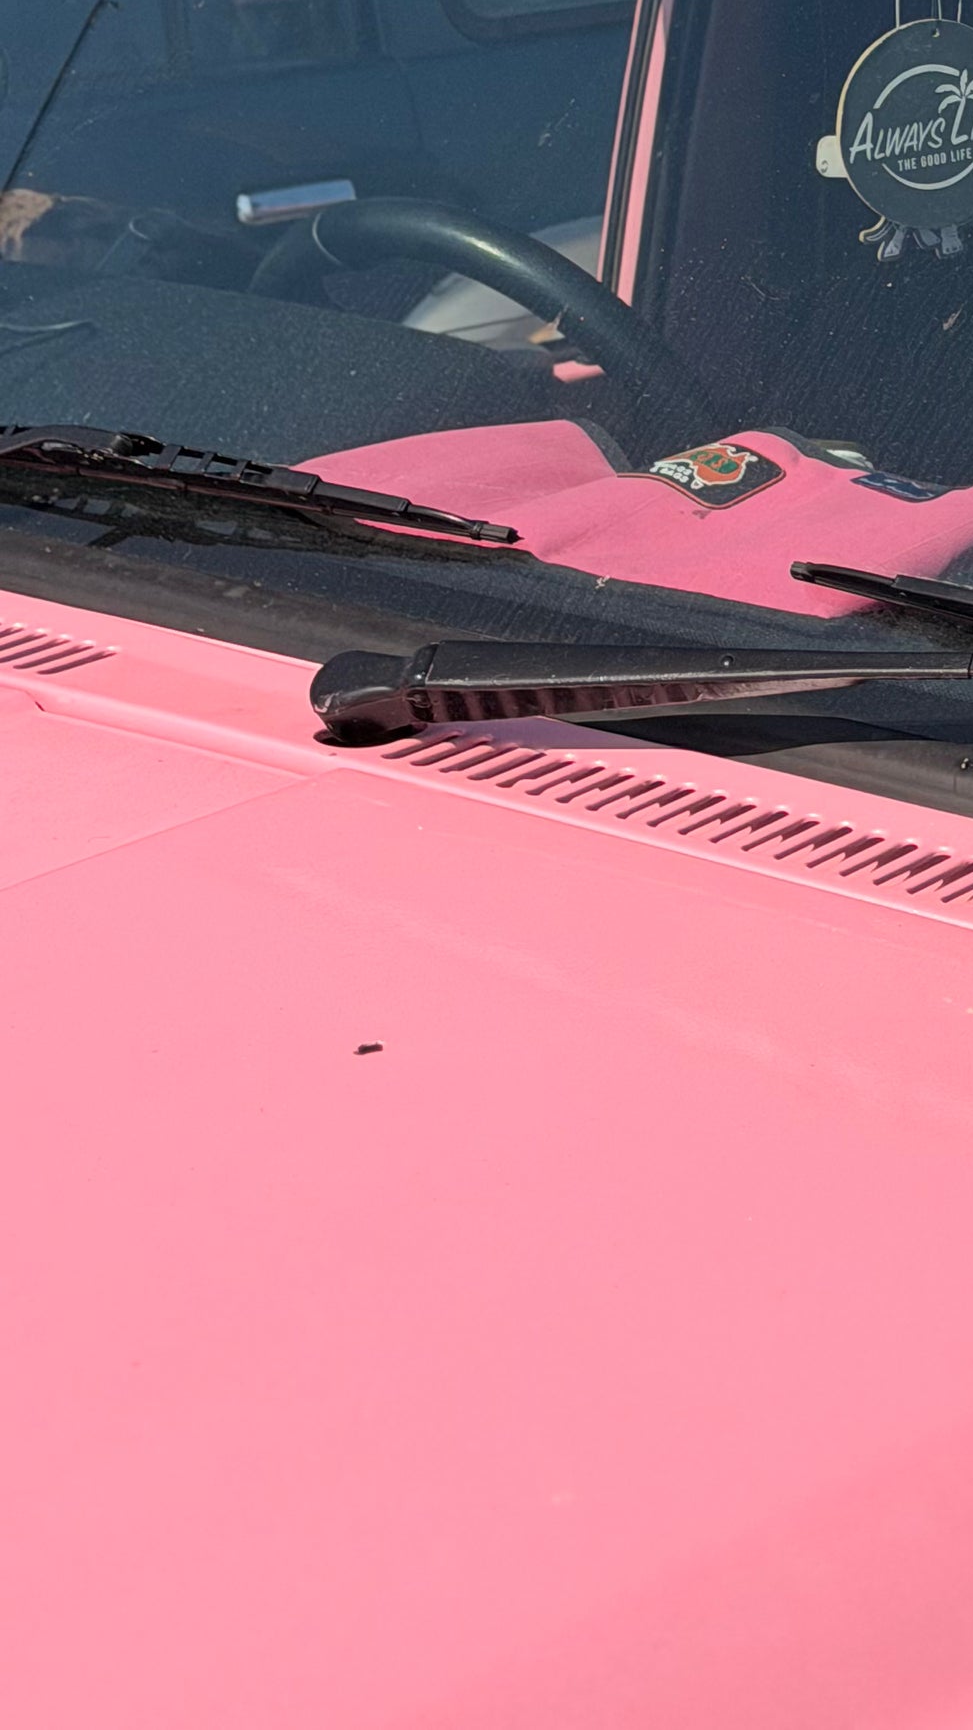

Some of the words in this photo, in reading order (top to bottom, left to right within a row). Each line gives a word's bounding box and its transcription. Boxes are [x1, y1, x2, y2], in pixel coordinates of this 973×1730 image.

[849, 111, 946, 164] ALWAYS
[898, 158, 917, 172] THE
[921, 152, 947, 168] GOOD
[950, 147, 973, 163] LIFE
